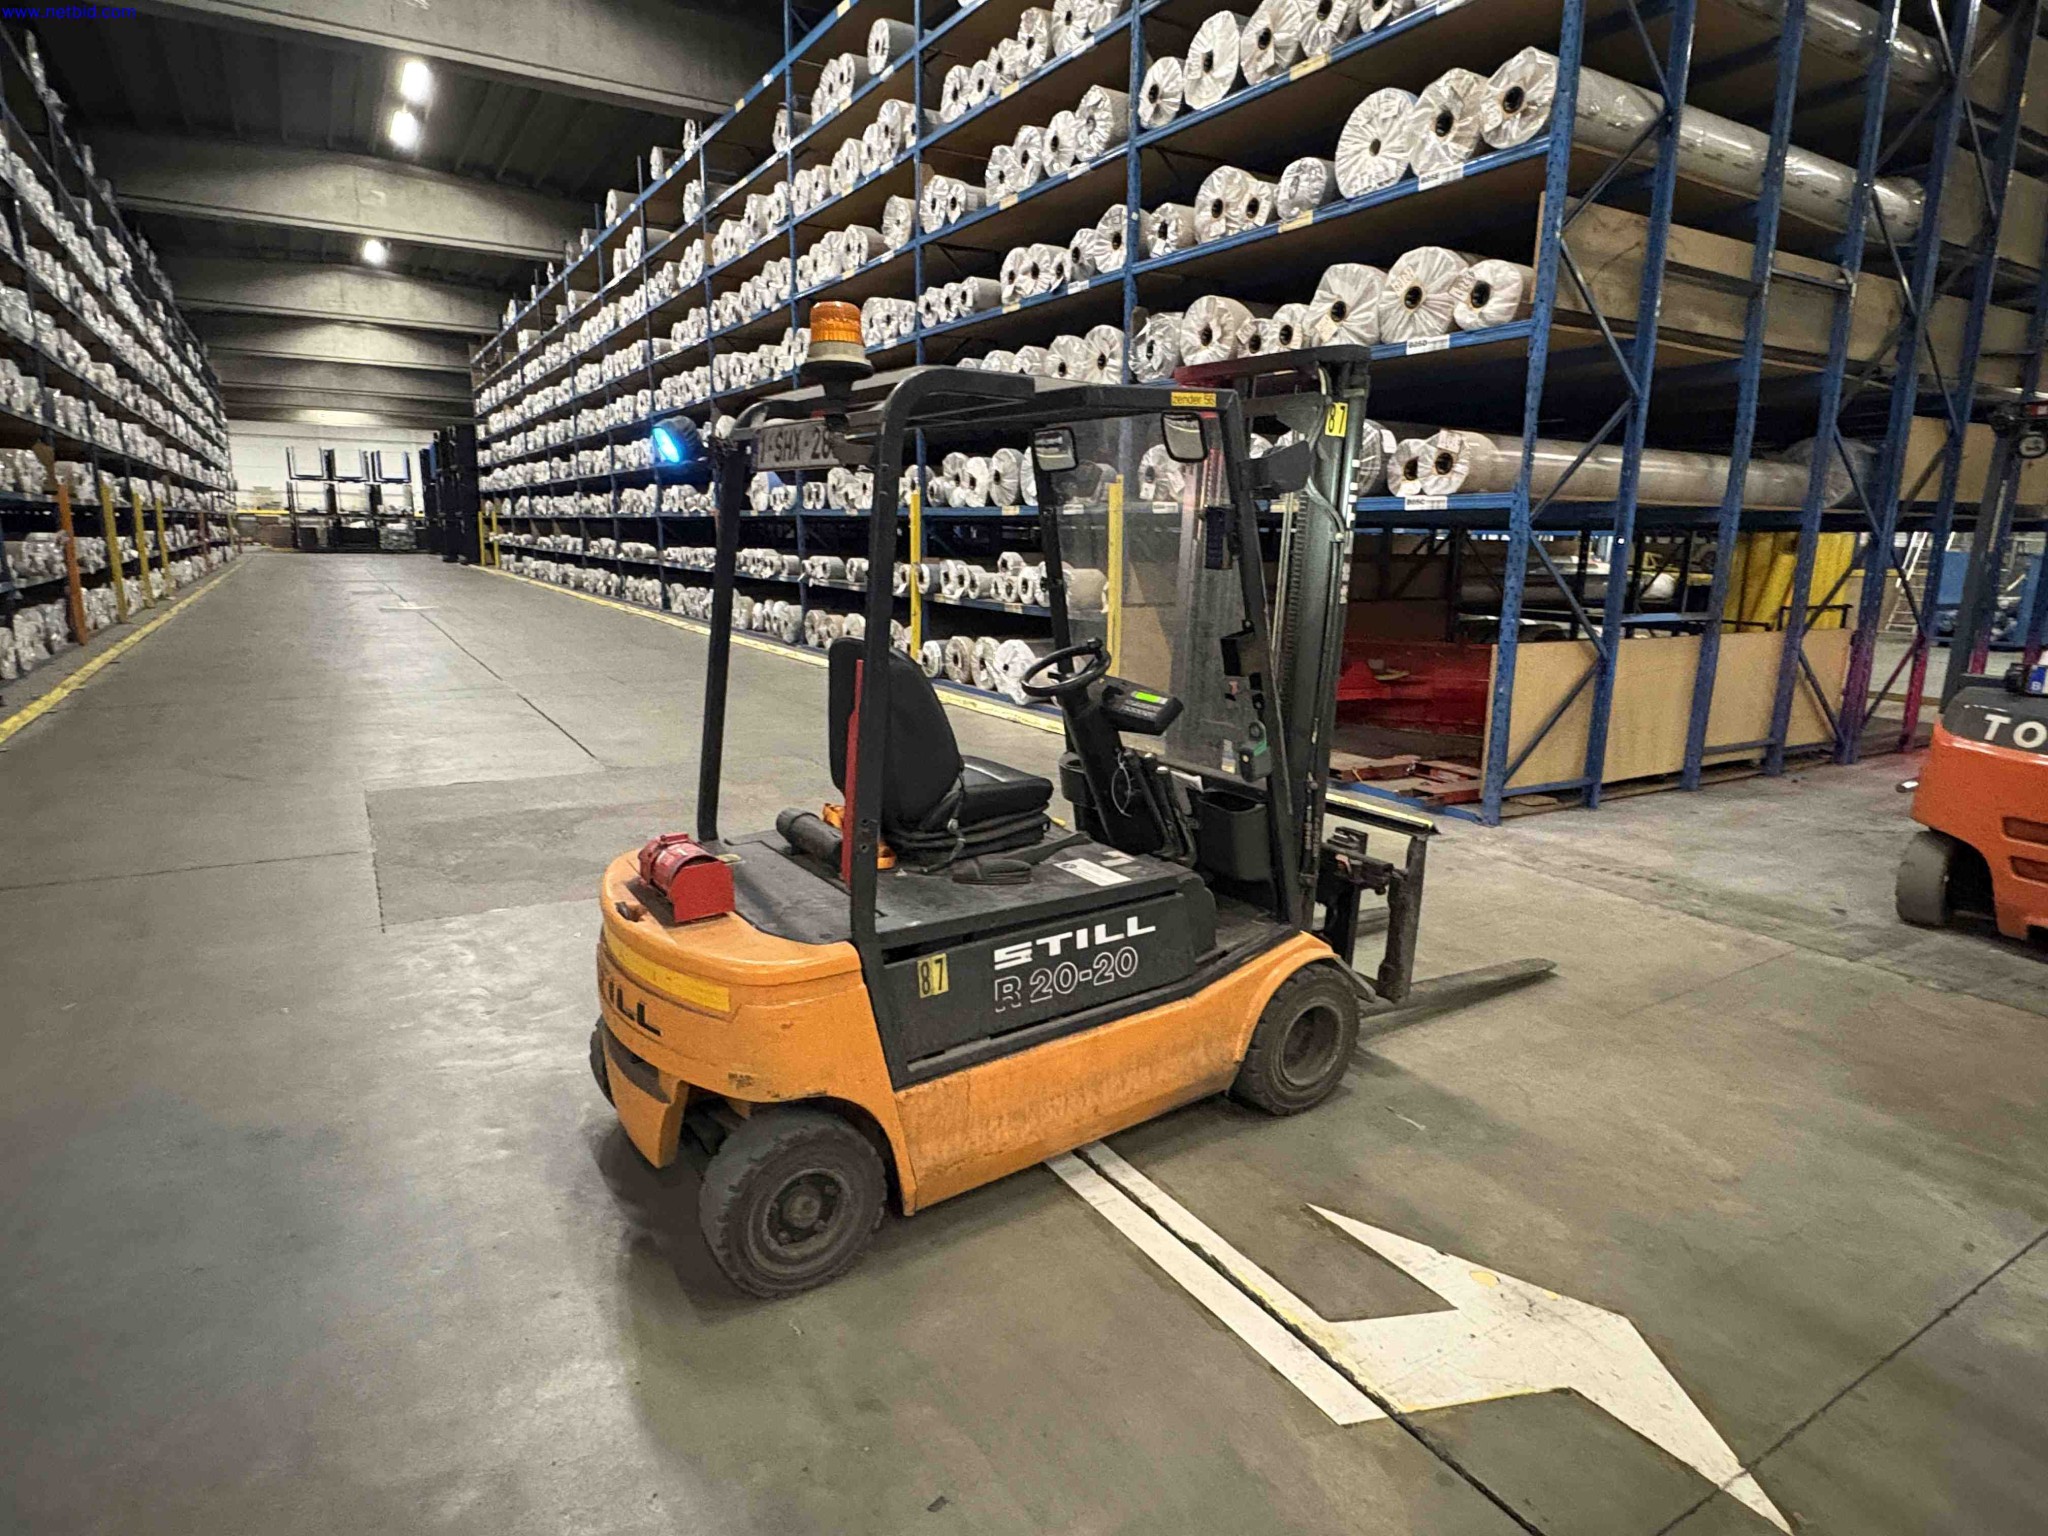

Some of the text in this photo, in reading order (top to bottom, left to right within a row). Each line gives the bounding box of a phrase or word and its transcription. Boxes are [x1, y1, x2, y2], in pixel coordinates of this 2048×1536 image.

[1328, 404, 1346, 434] 87
[760, 426, 834, 463] 1-SHX-28
[994, 916, 1157, 970] STILL
[920, 957, 946, 996] 87
[995, 946, 1139, 1013] R 20-20
